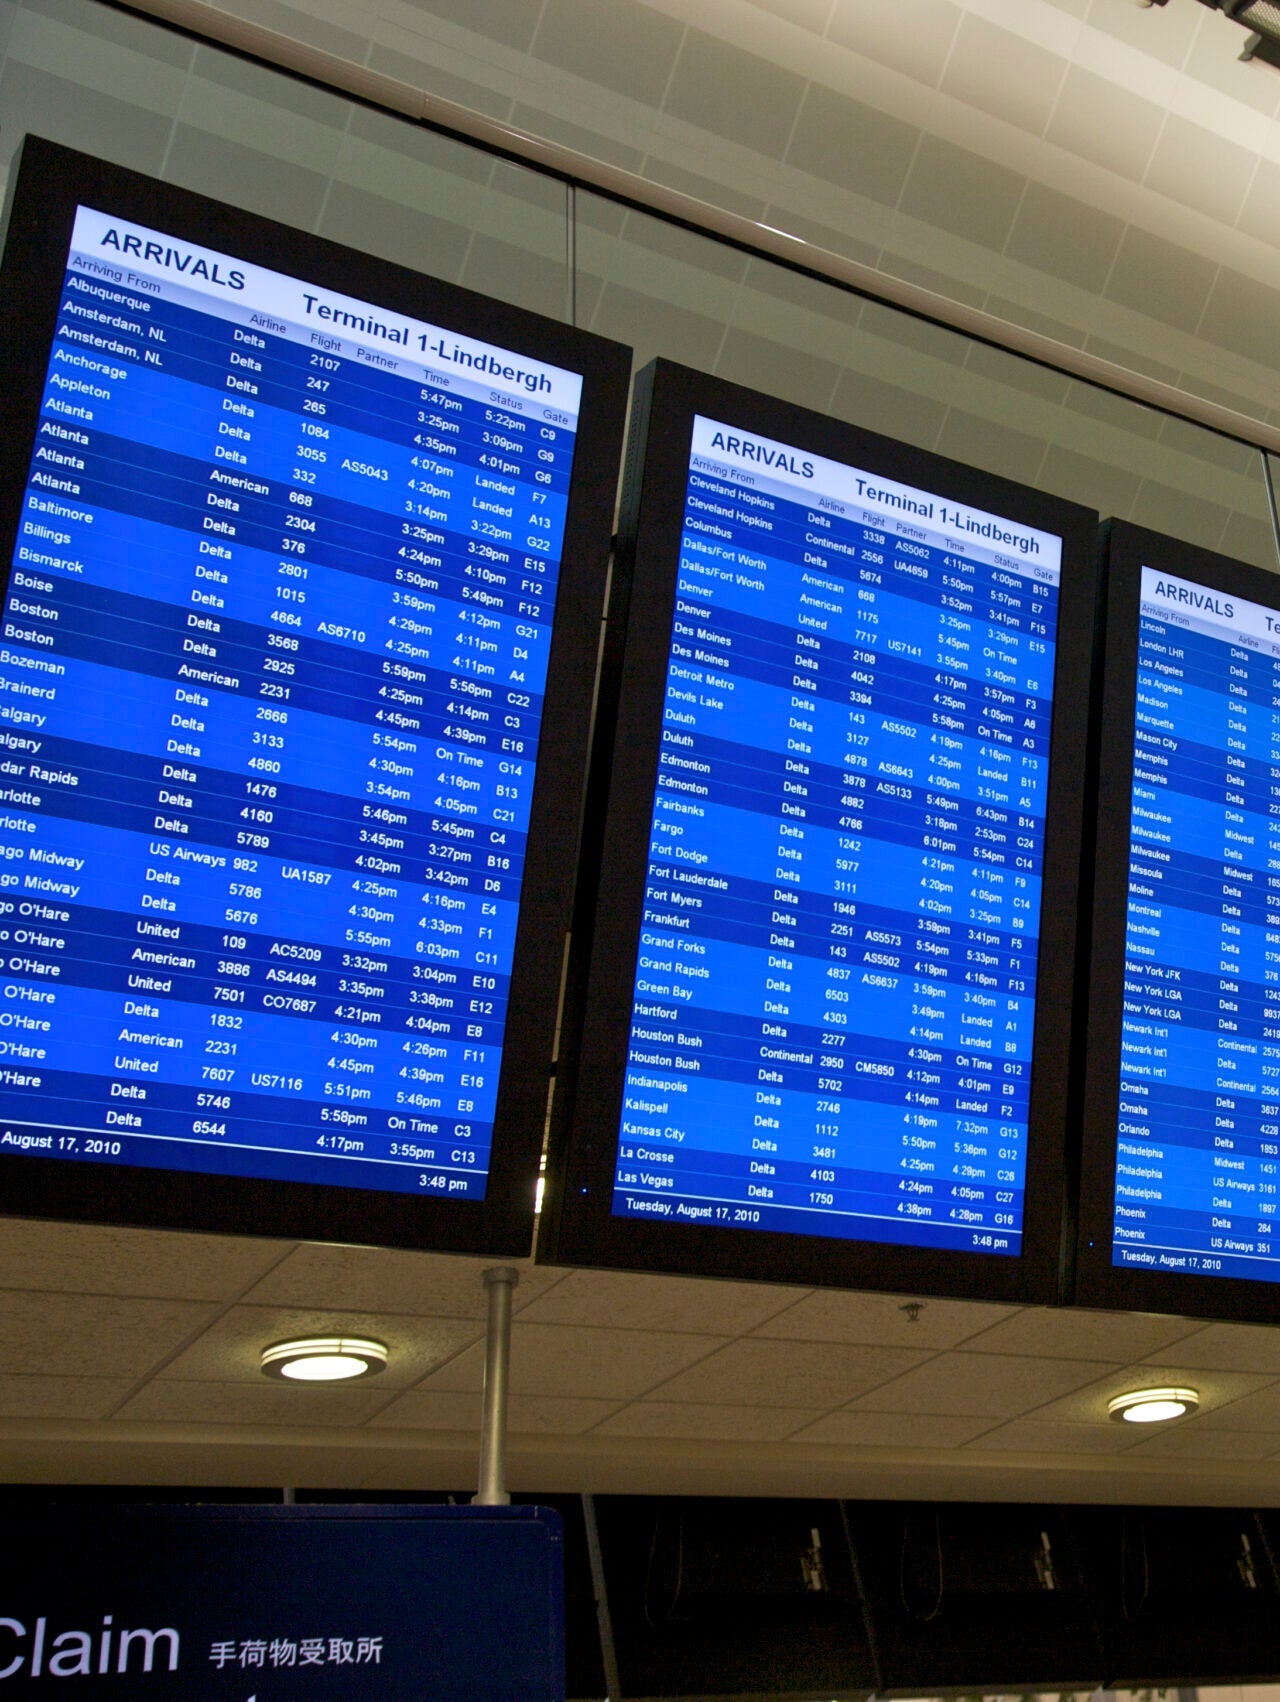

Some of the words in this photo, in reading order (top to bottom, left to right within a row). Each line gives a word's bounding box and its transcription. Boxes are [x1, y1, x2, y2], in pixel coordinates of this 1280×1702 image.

[72, 256, 123, 282] Arriving
[126, 271, 161, 294] From
[248, 312, 287, 334] Airline
[309, 331, 341, 352] Flight
[355, 346, 397, 370] Partner
[422, 368, 450, 387] Time
[489, 390, 523, 411] Status
[542, 407, 569, 426] Gate
[98, 226, 246, 292] ARRIVALS
[300, 291, 411, 347] Terminal
[416, 332, 553, 395] 1-Lindbergh
[65, 275, 151, 312] Albuquerque
[232, 328, 266, 349] Delta
[308, 352, 341, 372] 2107
[419, 387, 463, 411] 5:47pm
[484, 408, 526, 432] 5:22pm
[539, 426, 556, 441] C9
[48, 372, 111, 401] Appleton
[217, 420, 251, 442] Delta
[295, 444, 327, 463] 3055
[340, 458, 389, 481] AS5043
[406, 477, 451, 500] 4:20pm
[471, 496, 513, 518] Landed
[527, 513, 551, 529] A13
[686, 494, 735, 519] Cleveland
[735, 509, 773, 531] Hopkins
[804, 531, 856, 556] Continental
[709, 430, 815, 480] ARRIVALS
[853, 476, 935, 520] Terminal
[938, 505, 1041, 556] 1-Lindbergh
[1153, 578, 1235, 620] ARRIVALS
[673, 620, 694, 637] Des
[695, 627, 732, 647] Moines
[793, 653, 819, 671] Delta
[0, 649, 66, 676] Bozeman
[174, 687, 209, 707] Delta
[255, 706, 288, 725] 2666
[371, 731, 417, 753] 5:54pm
[434, 746, 454, 761] On
[455, 750, 484, 768] Time
[497, 760, 522, 776] G14
[647, 863, 671, 879] Fort
[671, 868, 729, 890] Lauderdale
[773, 888, 799, 905] Delta
[17, 901, 70, 922] O'Hare
[135, 920, 181, 940] United
[221, 934, 247, 950] 109
[268, 942, 322, 962] AC5209
[341, 953, 388, 973] 3:32pm
[411, 964, 457, 984] 3:04pm
[471, 974, 496, 990] E10
[0, 1012, 51, 1032] O'Hare
[117, 1027, 184, 1049] American
[203, 1039, 237, 1056] 2231
[326, 1056, 375, 1074] 4:45pm
[398, 1065, 445, 1084] 4:39pm
[459, 1073, 484, 1089] E16
[630, 1025, 675, 1043] Houston
[676, 1032, 703, 1048] Bush
[758, 1045, 814, 1065] Continental
[0, 1130, 53, 1150] August
[57, 1135, 79, 1153] 17,
[83, 1138, 121, 1156] 2010
[418, 1173, 447, 1189] 3:48
[447, 1179, 468, 1192] pm
[625, 1196, 674, 1216] Tuesday,
[675, 1202, 713, 1219] August
[715, 1206, 731, 1221] 17,
[733, 1208, 760, 1223] 2010
[971, 1233, 993, 1247] 3:48
[992, 1237, 1009, 1249] pm
[1120, 1248, 1158, 1265] Tuesday,
[1158, 1253, 1186, 1268] August
[1187, 1256, 1200, 1269] 17,
[1201, 1257, 1222, 1271] 2010
[0, 1614, 180, 1680] Claim
[208, 1636, 384, 1669] 手荷物受取所
